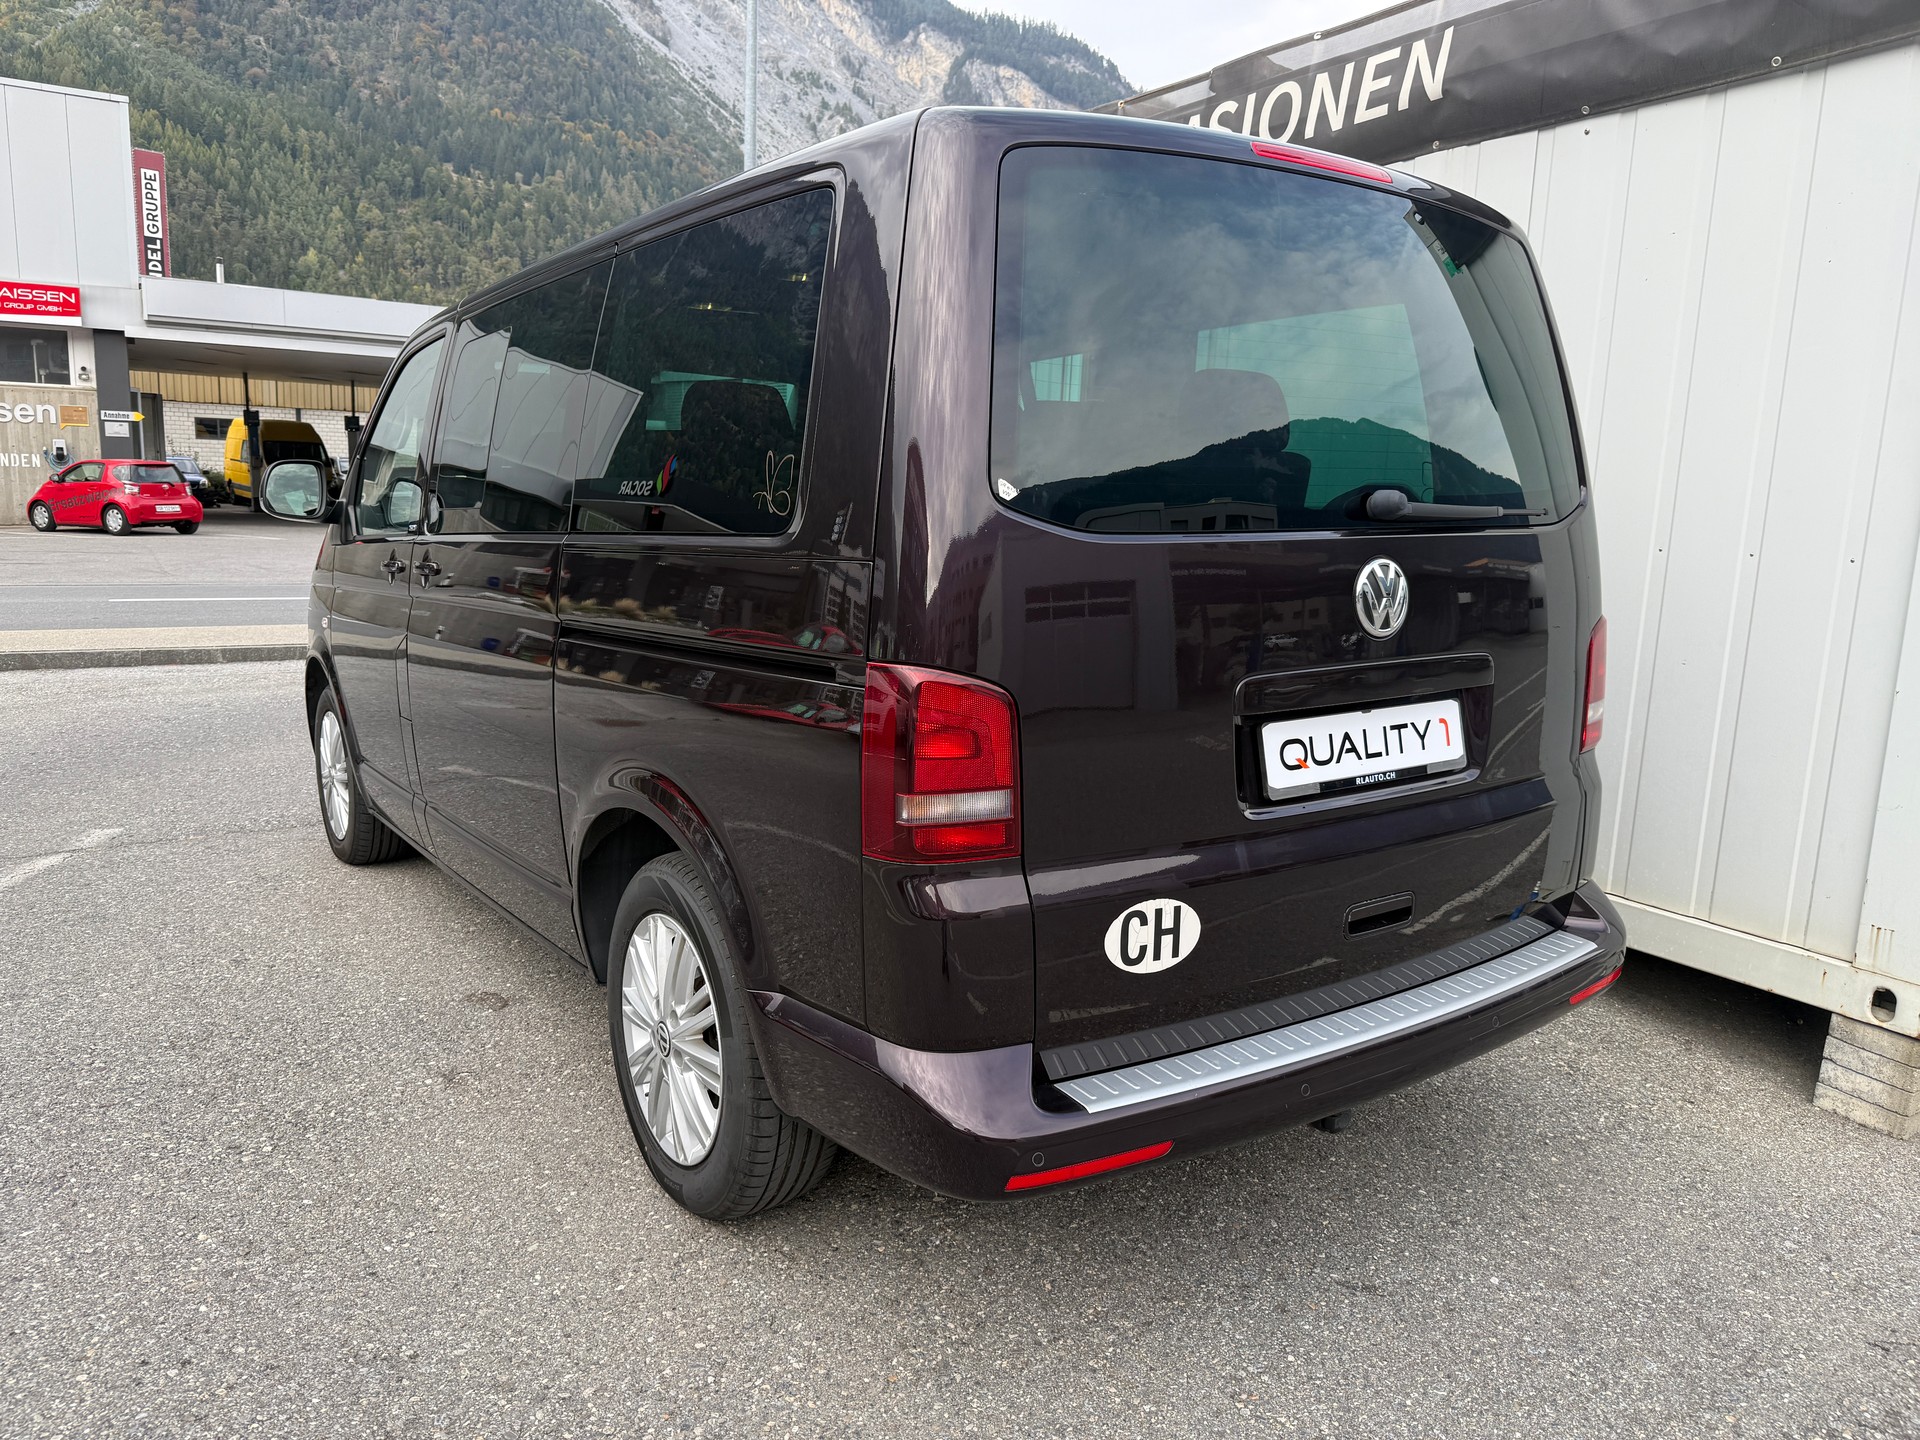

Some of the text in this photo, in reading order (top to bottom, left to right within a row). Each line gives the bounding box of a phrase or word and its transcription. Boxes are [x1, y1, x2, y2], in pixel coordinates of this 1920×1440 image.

[4, 302, 63, 312] GROUP GMBH
[103, 411, 130, 420] Annahme
[0, 453, 41, 468] NDEN
[1279, 719, 1432, 771] QUALITY
[1355, 771, 1396, 786] RLAUTO.CH
[1120, 904, 1182, 967] CH
